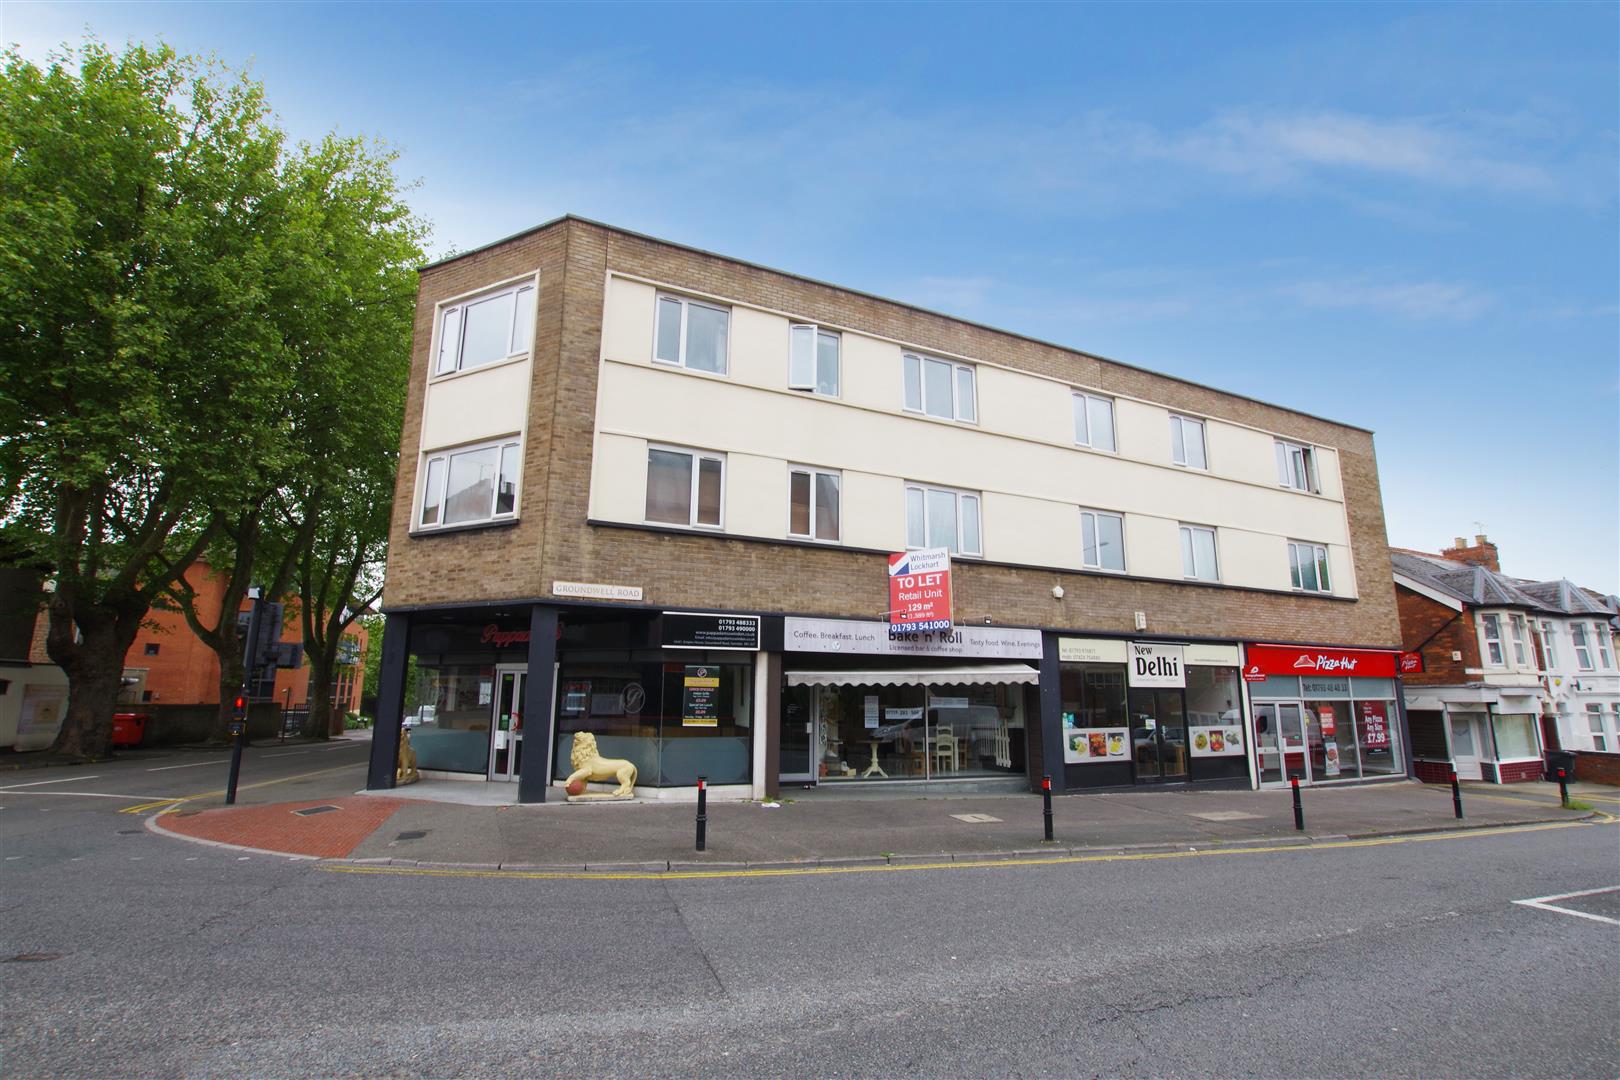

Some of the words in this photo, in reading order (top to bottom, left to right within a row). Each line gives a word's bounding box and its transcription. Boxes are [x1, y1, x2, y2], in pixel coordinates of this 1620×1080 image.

[910, 552, 946, 562] Whitmarsh
[910, 561, 939, 570] Lockhart
[897, 577, 914, 588] TO
[918, 574, 942, 586] LET
[556, 584, 615, 596] GROUNDWELL
[617, 589, 640, 597] ROAD
[898, 591, 922, 600] Retail
[924, 589, 942, 598] Unit
[908, 603, 922, 612] 129
[892, 623, 916, 632] 01793
[919, 620, 950, 630] 541000
[888, 628, 918, 641] bake
[940, 632, 962, 644] Roll
[970, 639, 984, 647] Tasty
[1134, 646, 1152, 655] New
[1136, 656, 1178, 676] Delhi
[1316, 654, 1340, 670] Pizza
[1340, 656, 1358, 670] Hut
[1368, 732, 1385, 743] £7.99
